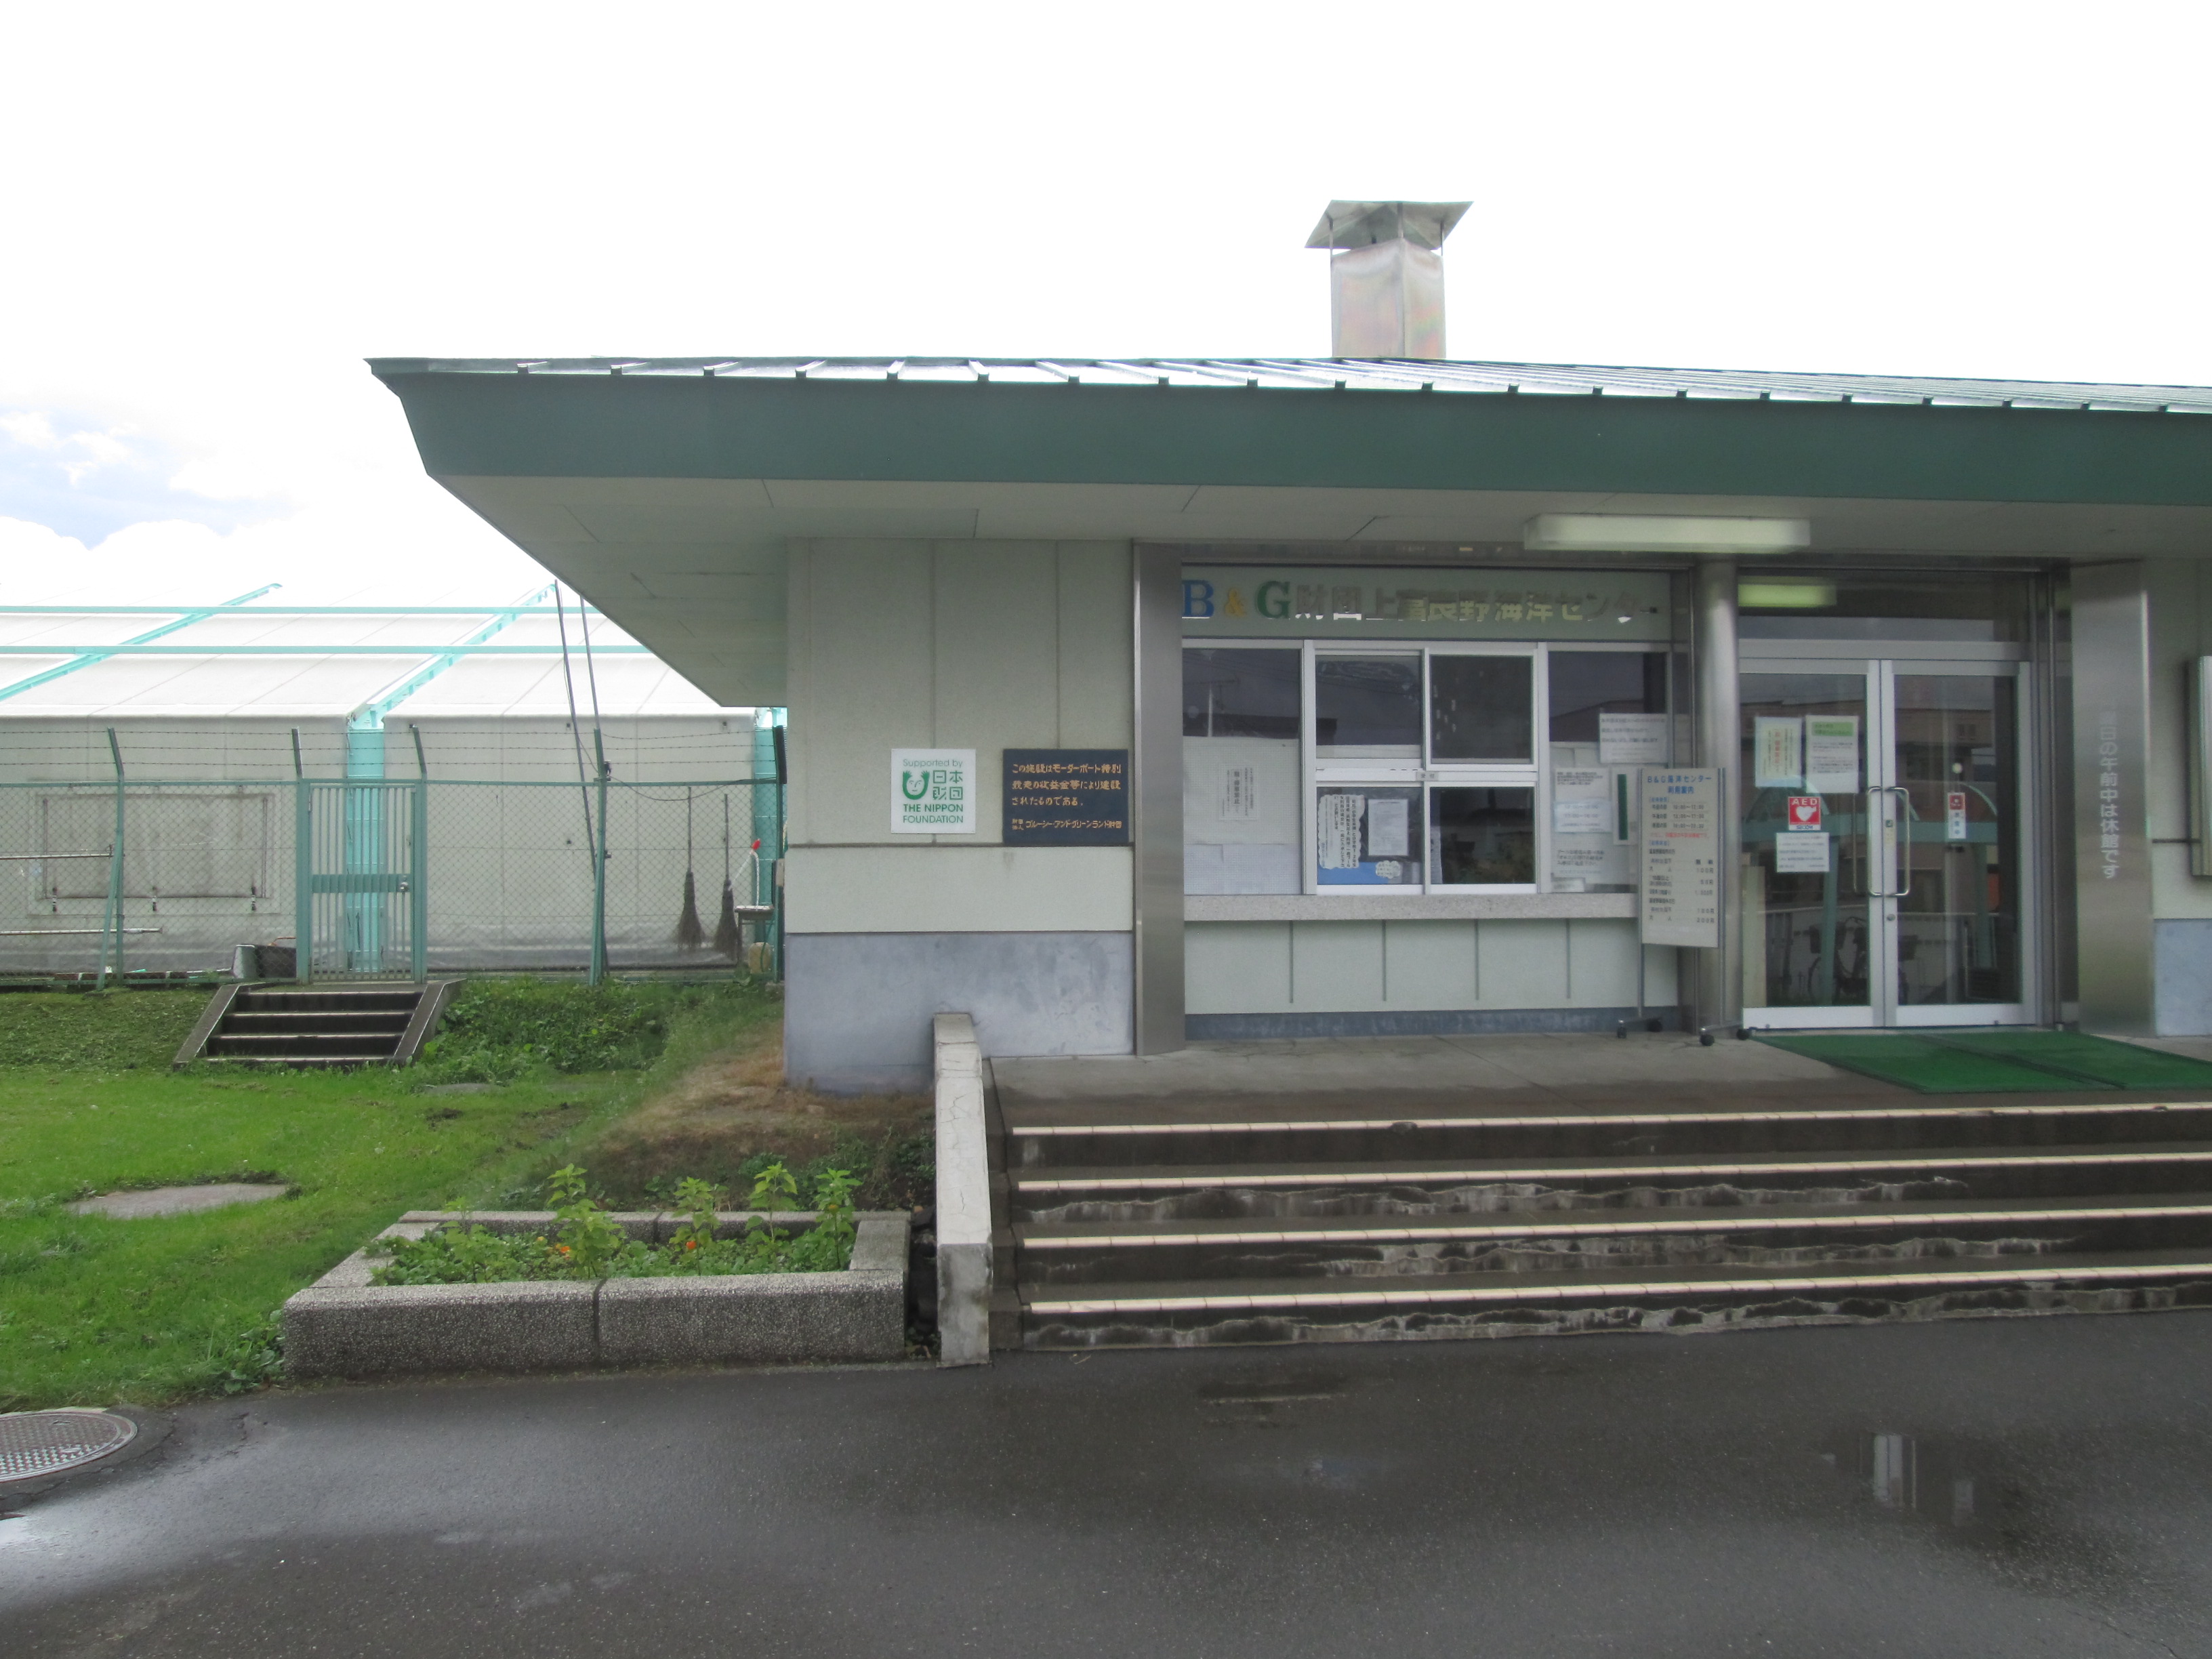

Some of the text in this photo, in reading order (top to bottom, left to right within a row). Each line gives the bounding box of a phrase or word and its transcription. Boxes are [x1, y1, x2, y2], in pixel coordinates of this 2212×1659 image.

[903, 759, 962, 768] Supported by
[933, 770, 963, 784] 日本
[903, 804, 963, 812] THE NIPPON
[903, 815, 963, 823] FOUNDATION
